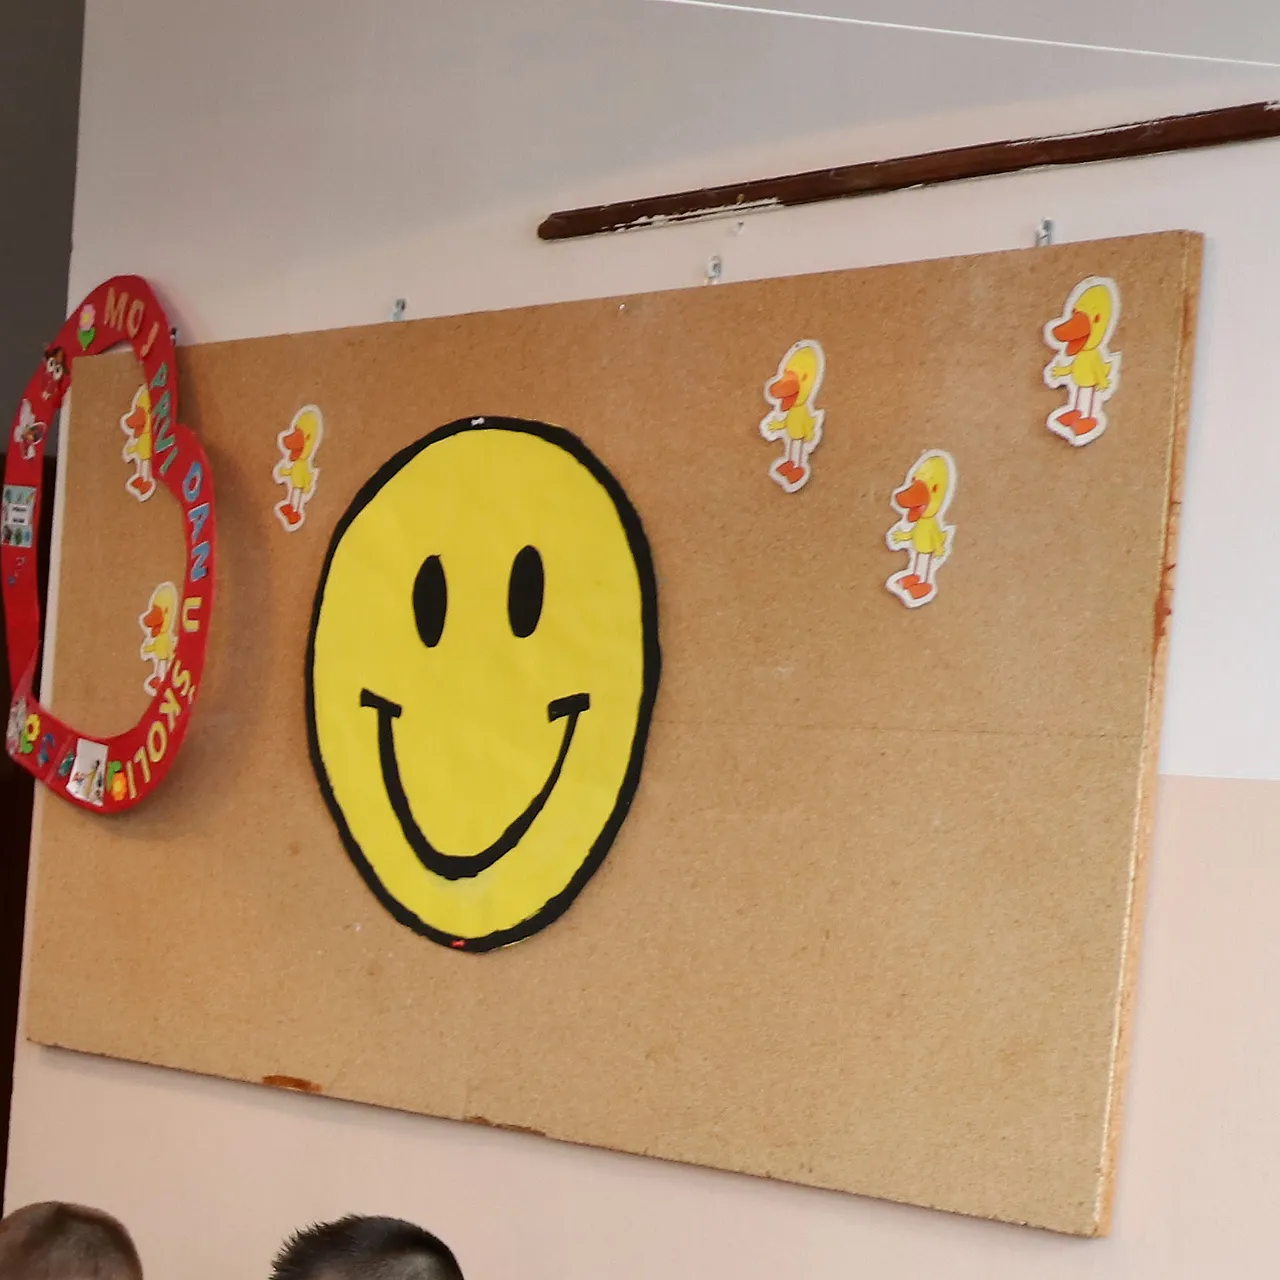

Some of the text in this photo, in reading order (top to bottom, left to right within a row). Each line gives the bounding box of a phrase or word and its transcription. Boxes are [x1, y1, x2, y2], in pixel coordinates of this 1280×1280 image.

[104, 286, 211, 800] MOJ PRVI DAN U ŠKOLI
